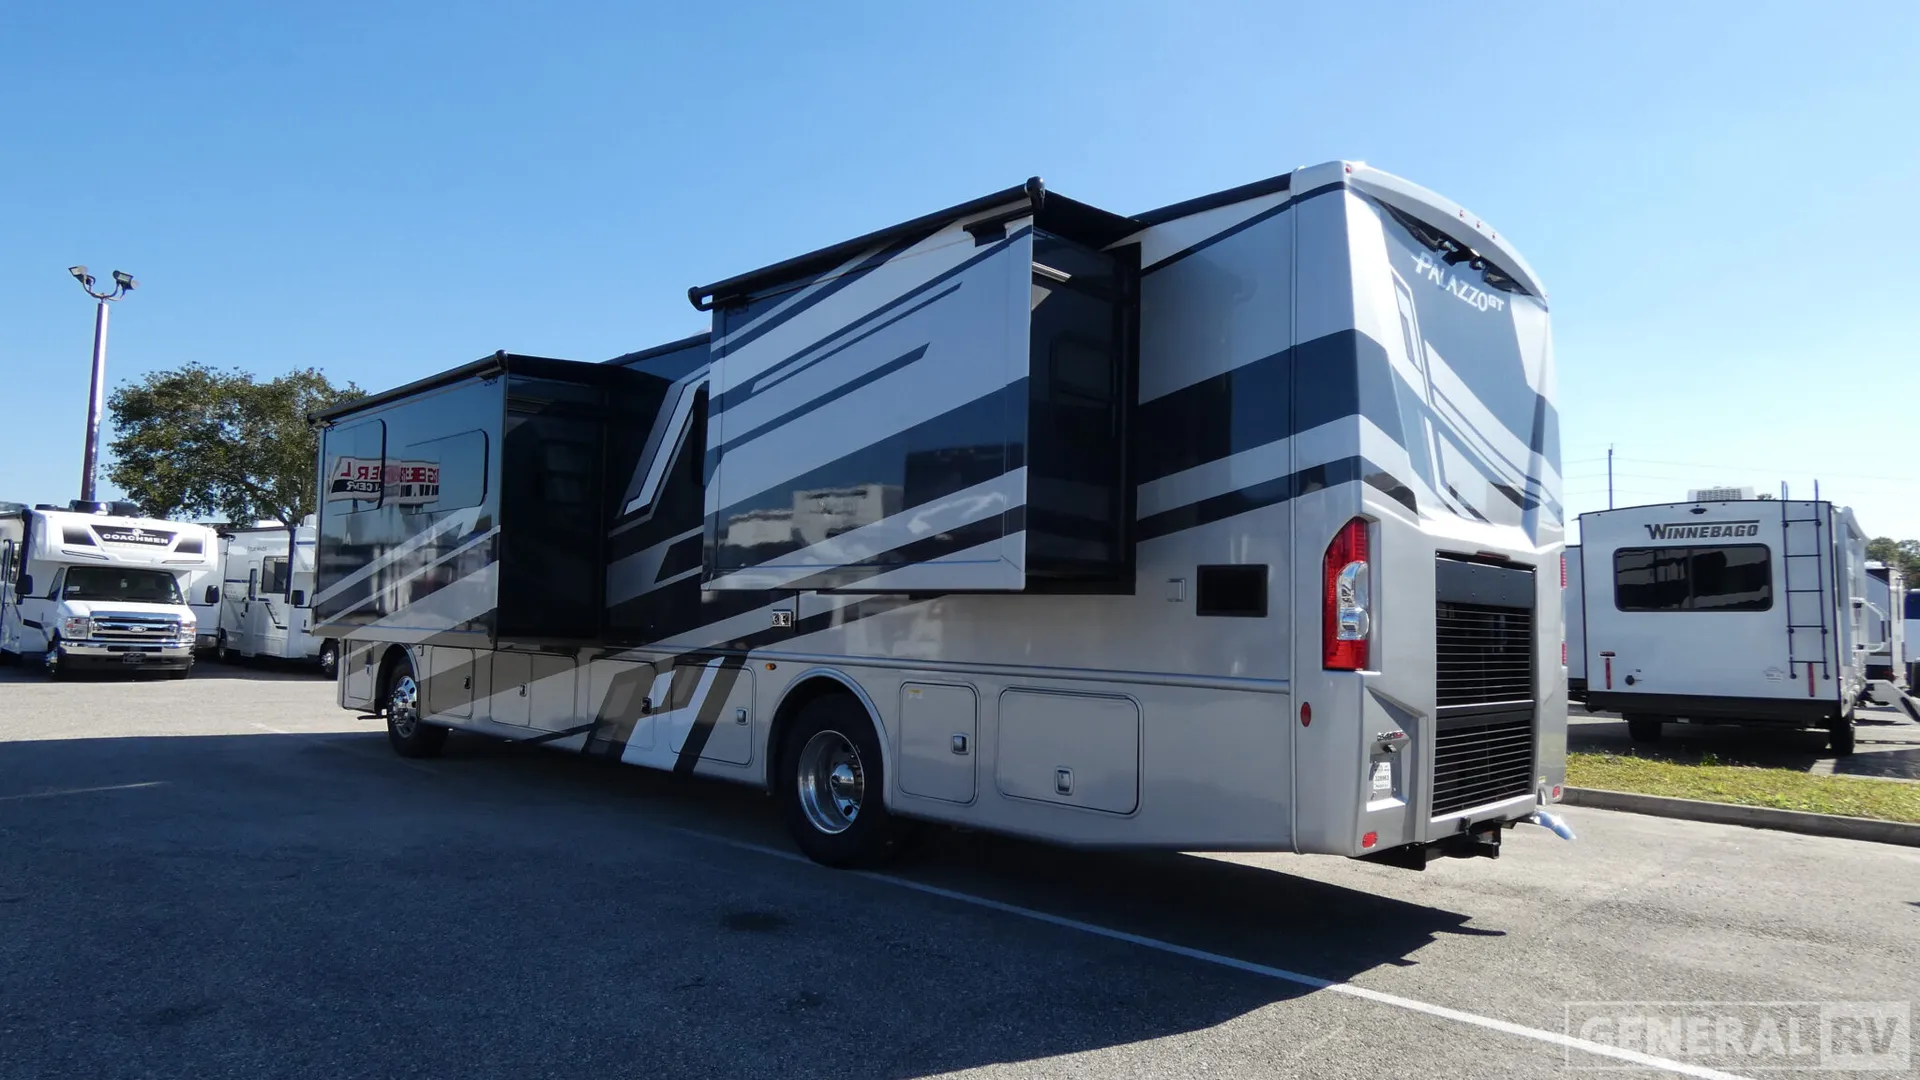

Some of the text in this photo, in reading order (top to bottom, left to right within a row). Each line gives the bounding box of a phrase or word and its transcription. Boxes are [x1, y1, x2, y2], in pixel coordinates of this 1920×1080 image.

[1411, 252, 1505, 312] PALAZZO GT
[102, 533, 169, 544] COACHMEN
[1644, 520, 1760, 540] WINNEBAGO
